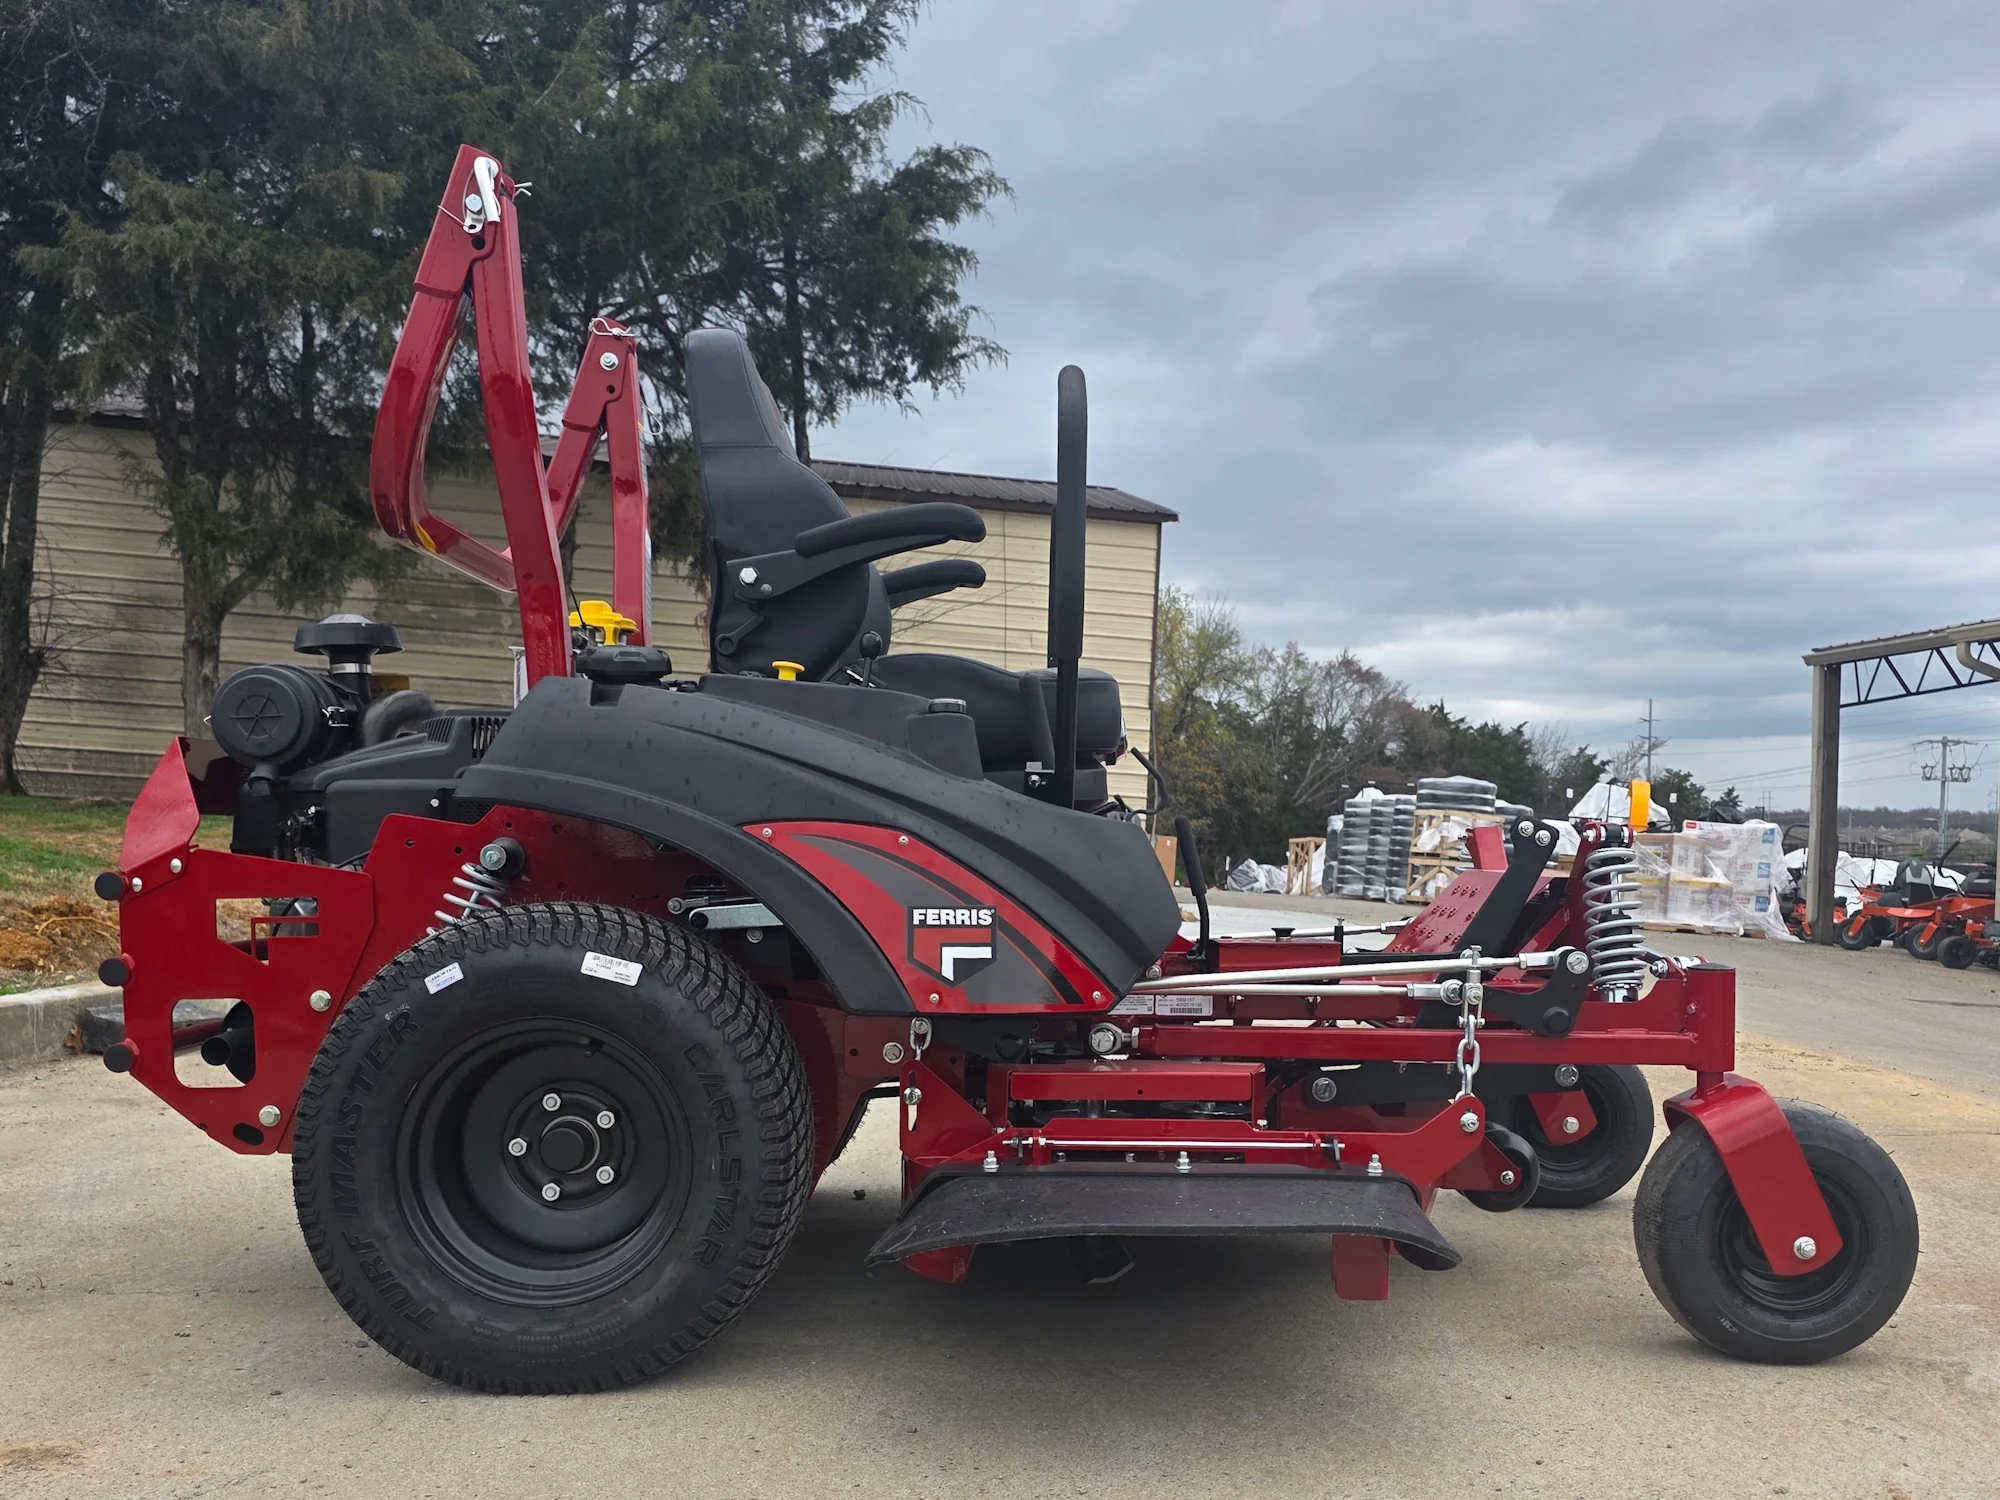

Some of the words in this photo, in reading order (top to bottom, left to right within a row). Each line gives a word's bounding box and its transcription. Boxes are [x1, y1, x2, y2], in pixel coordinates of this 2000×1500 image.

[913, 908, 993, 925] FERRIS
[328, 1010, 420, 1218] MASTER
[683, 1041, 743, 1267] CARLSTAR
[342, 1231, 440, 1333] TURF
